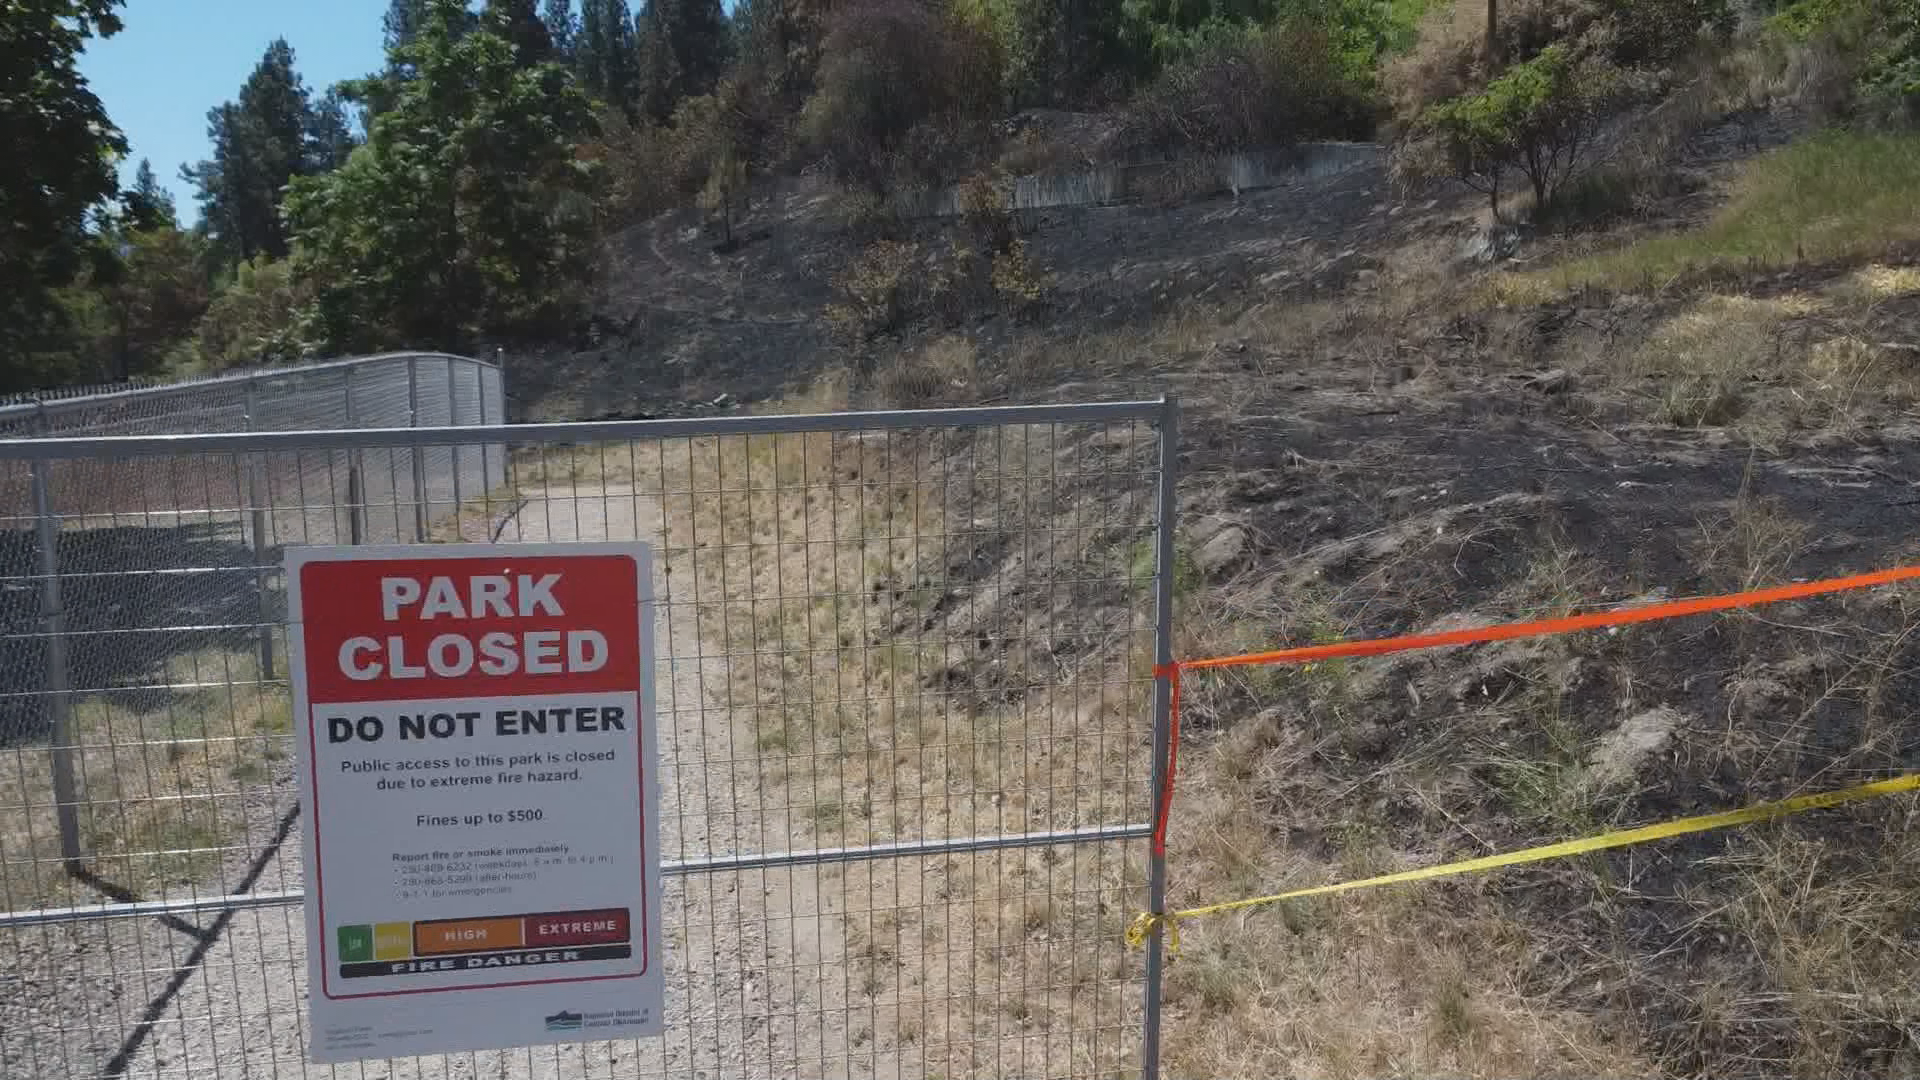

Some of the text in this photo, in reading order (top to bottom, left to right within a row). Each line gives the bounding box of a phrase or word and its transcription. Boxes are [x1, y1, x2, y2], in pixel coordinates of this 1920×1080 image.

[381, 573, 565, 621] PARK
[338, 629, 609, 681] CLOSED
[327, 706, 626, 743] DO NOT ENTER
[341, 749, 616, 772] Public access to this park is closed
[376, 768, 583, 790] due to extreme fire hazard.
[416, 814, 459, 826] Fines
[464, 814, 484, 829] up
[488, 812, 504, 824] to
[392, 844, 570, 862] Report fire or smoke immediately
[445, 920, 616, 941] HIGH EXTREME
[391, 950, 580, 974] FIRE DANGER
